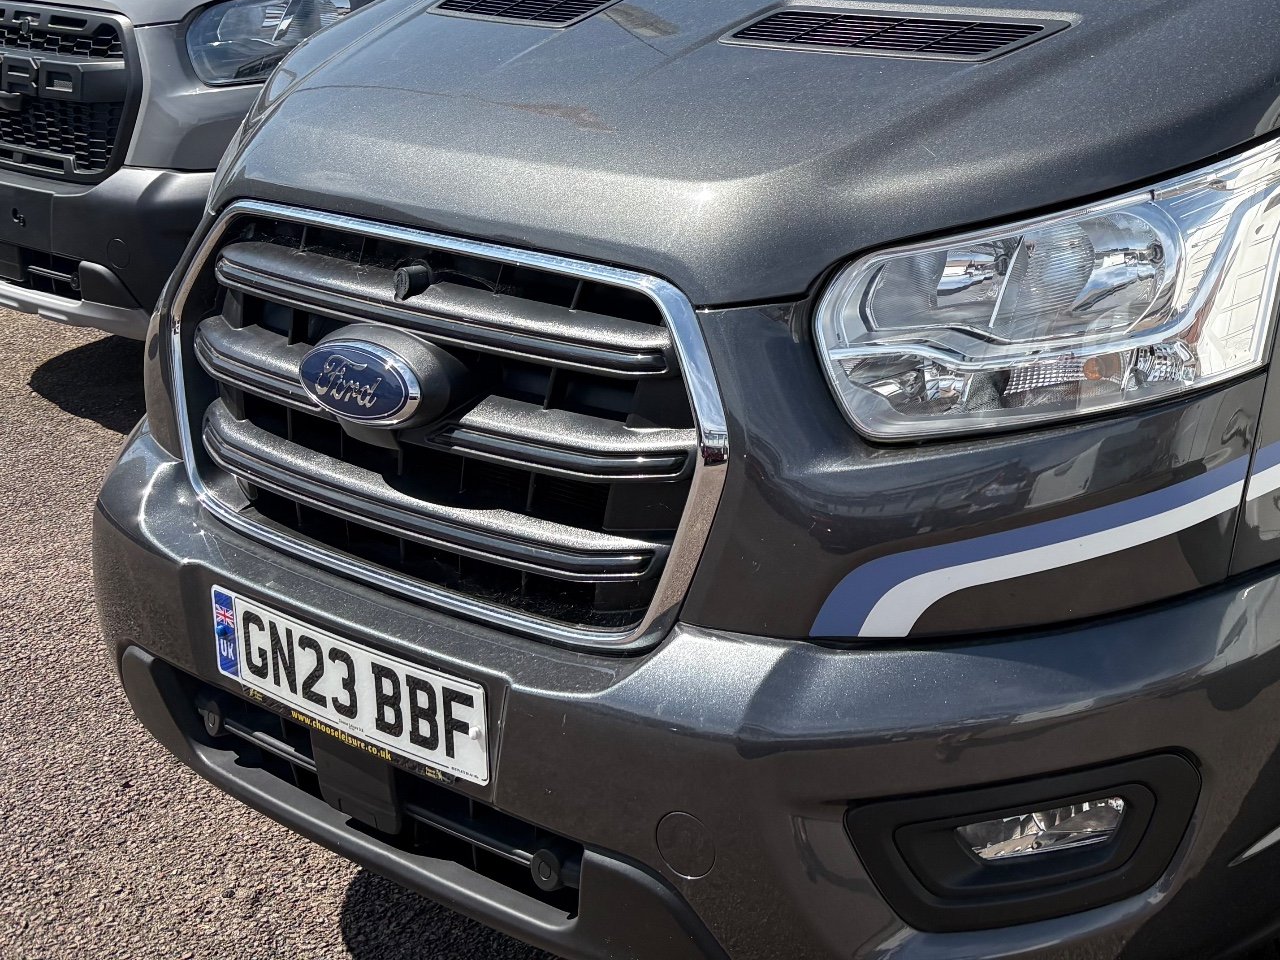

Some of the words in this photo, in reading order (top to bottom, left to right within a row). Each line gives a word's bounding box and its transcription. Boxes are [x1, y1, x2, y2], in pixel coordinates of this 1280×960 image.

[314, 354, 383, 409] Ford
[219, 638, 235, 661] UK
[242, 610, 358, 720] GN23
[370, 661, 475, 760] BBF
[290, 709, 392, 762] www.chooseleisure.co.uk
